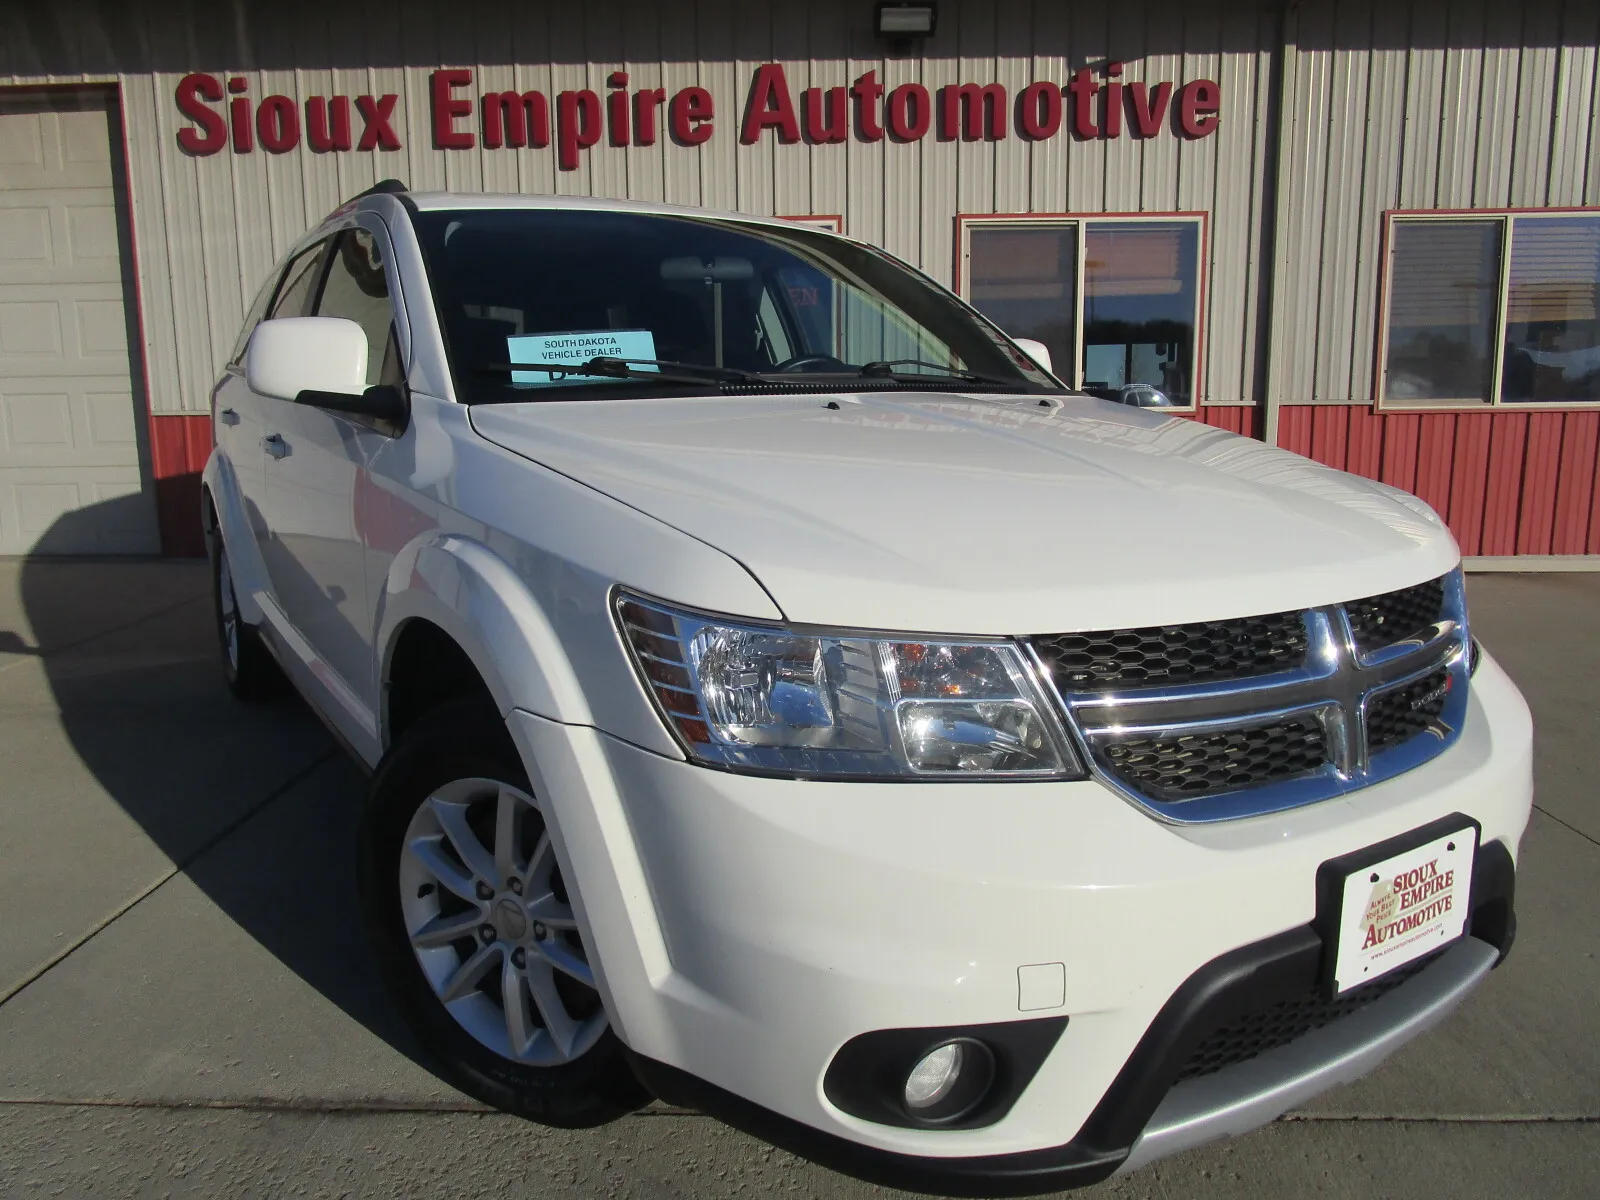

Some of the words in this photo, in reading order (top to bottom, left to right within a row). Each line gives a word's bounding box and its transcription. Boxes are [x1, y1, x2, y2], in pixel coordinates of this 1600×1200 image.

[176, 73, 401, 156] Sioux
[430, 69, 715, 171] Empire
[740, 63, 1221, 145] Automotive
[542, 349, 582, 360] VEHICLE
[584, 347, 622, 357] DEALER
[544, 340, 577, 349] SOUTH
[578, 338, 617, 346] DAKOTA
[1393, 858, 1438, 894] SIOUX
[1400, 869, 1454, 910] EMPIRE
[1361, 895, 1453, 950] AUTOMOTIVE
